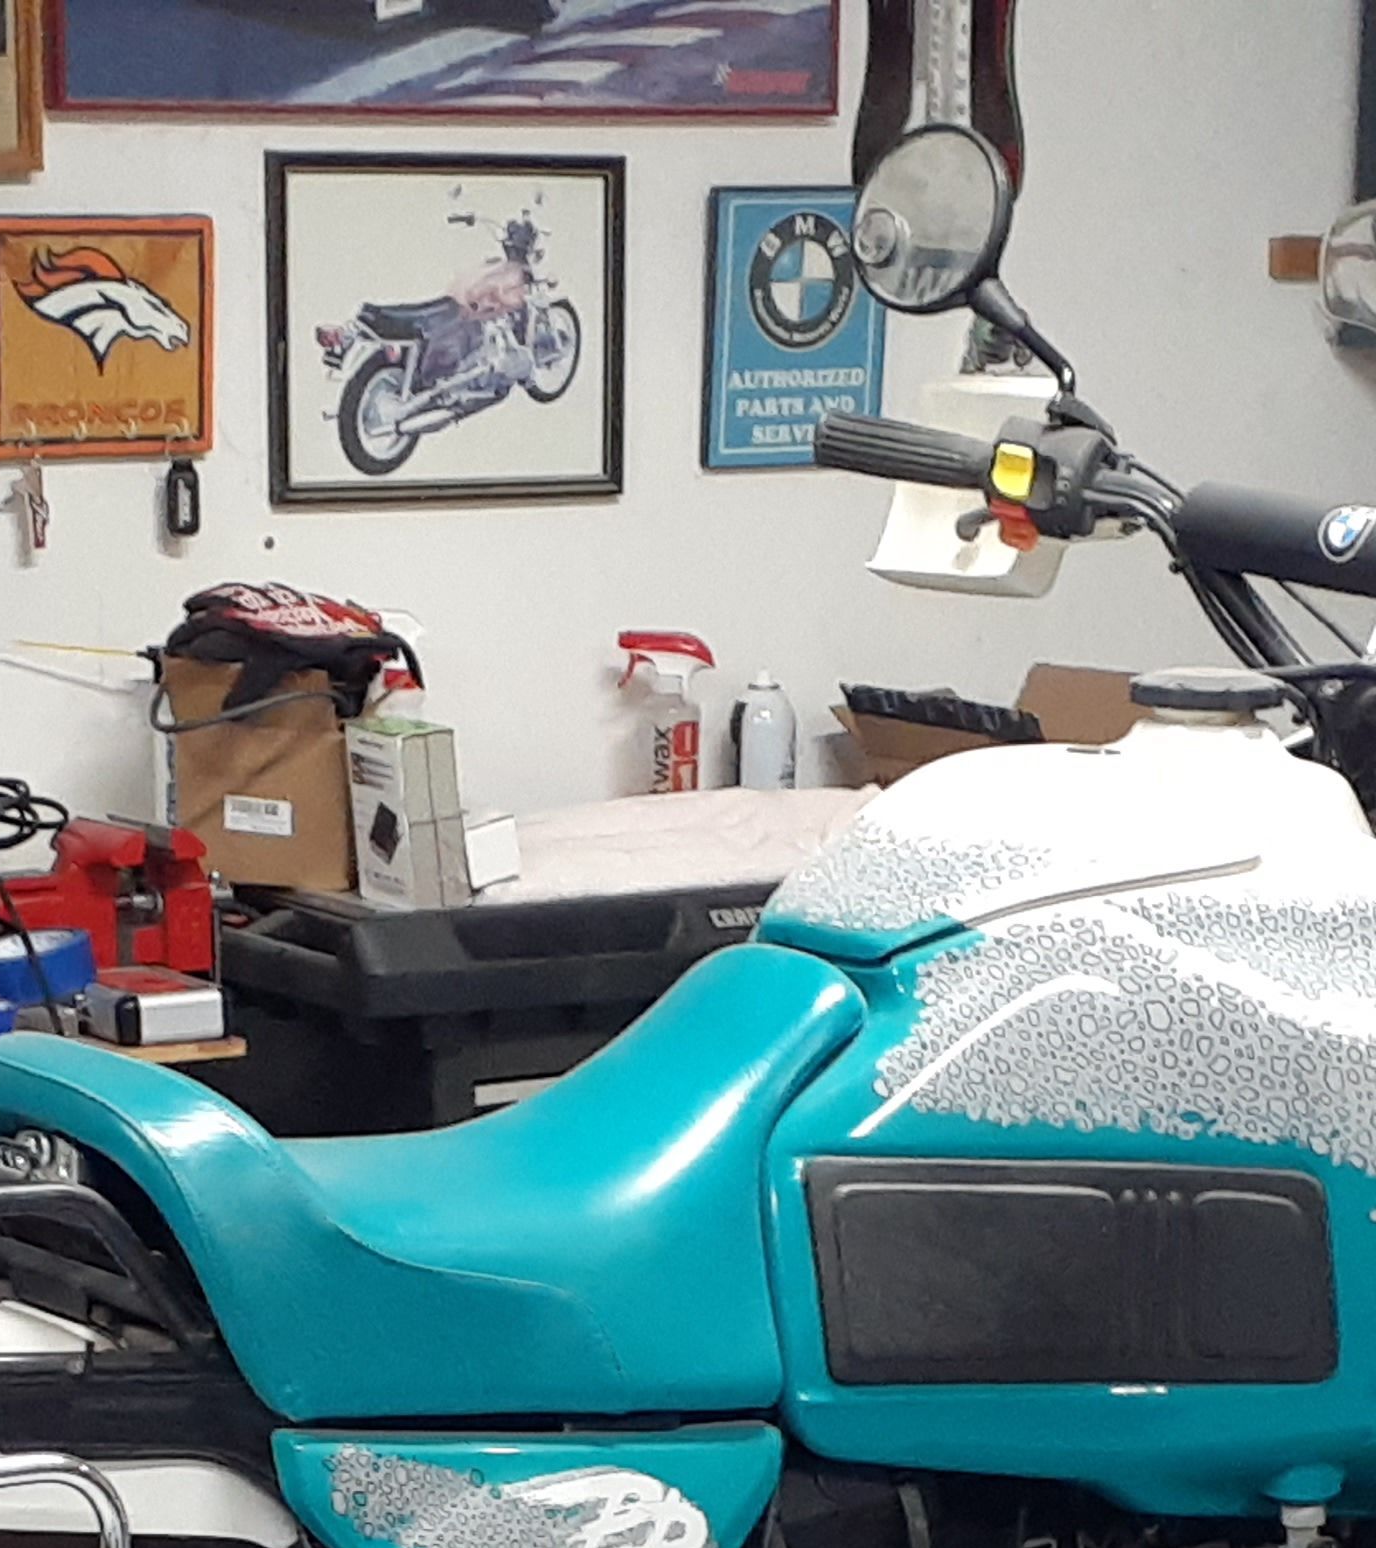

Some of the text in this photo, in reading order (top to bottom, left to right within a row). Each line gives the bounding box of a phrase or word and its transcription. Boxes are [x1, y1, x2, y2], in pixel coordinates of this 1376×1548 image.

[728, 367, 866, 389] AUTHORIZED
[11, 398, 187, 426] BRONCOS
[736, 398, 805, 417] PARTS
[751, 423, 815, 444] SERVI
[708, 907, 763, 928] CRAF
